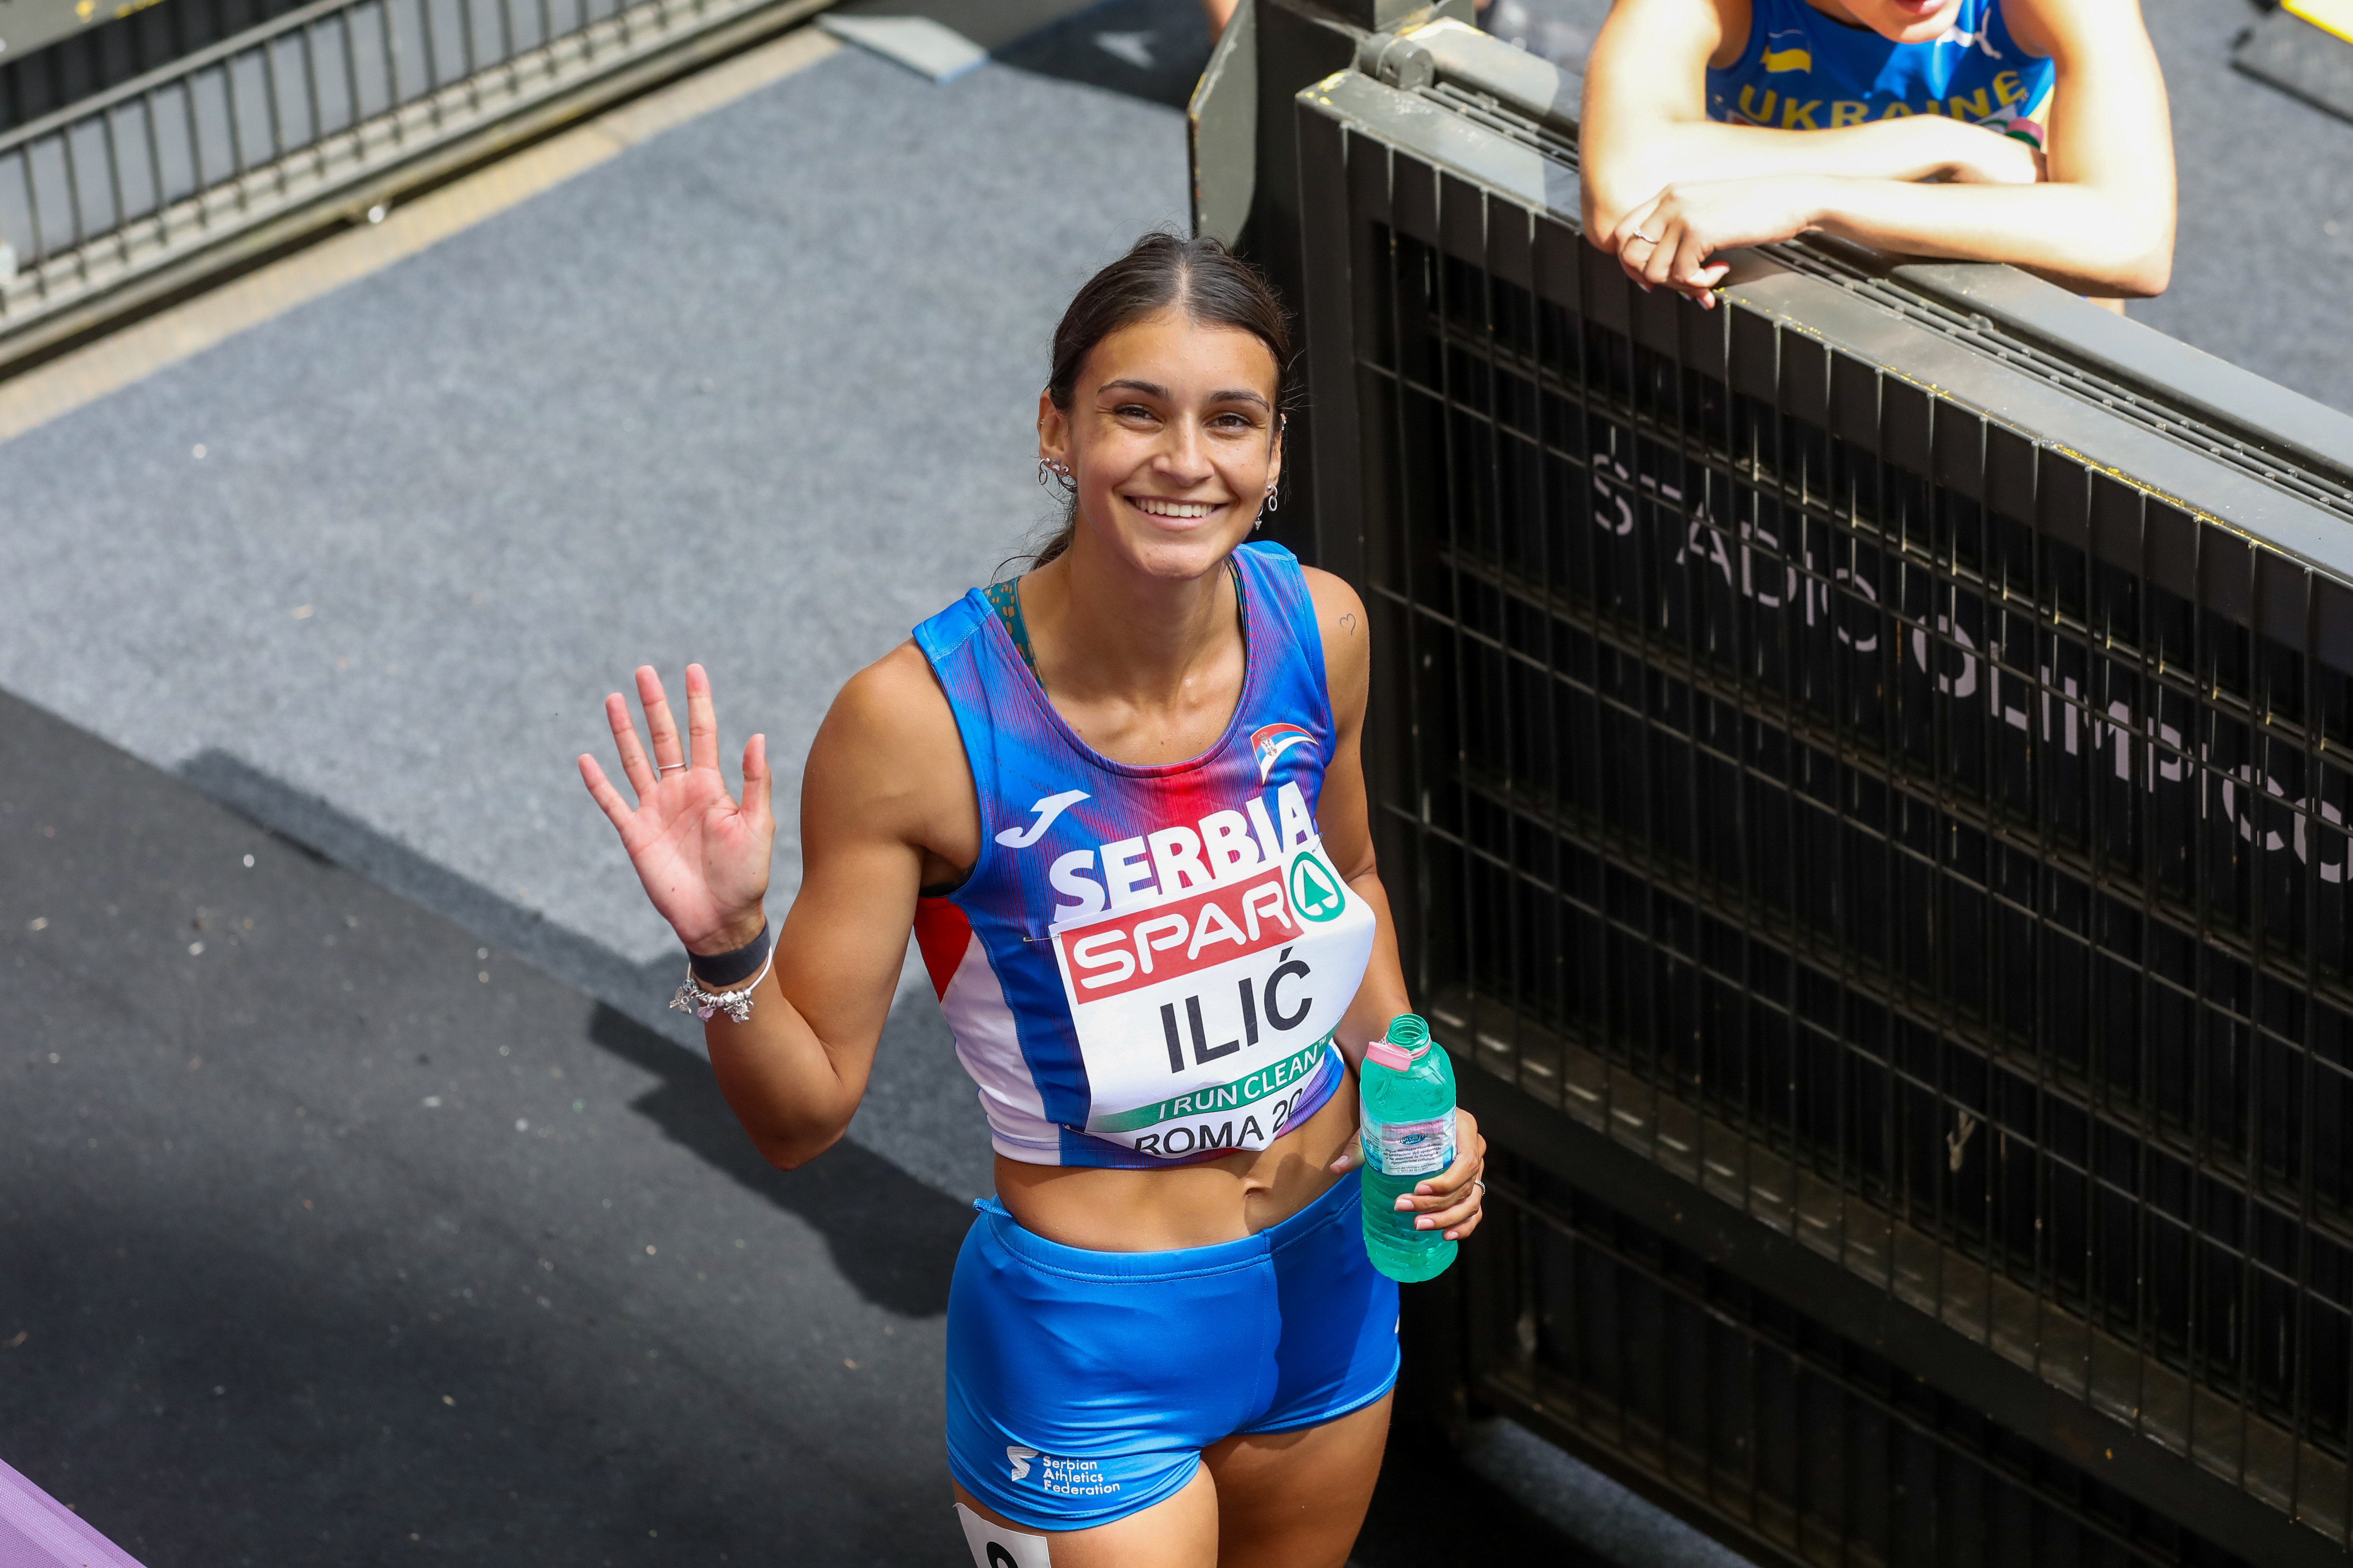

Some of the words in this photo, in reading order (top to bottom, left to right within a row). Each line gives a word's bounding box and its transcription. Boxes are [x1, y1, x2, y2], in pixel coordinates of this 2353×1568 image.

[1049, 780, 1315, 923] SERBIA
[1073, 881, 1291, 989] SPAR
[1160, 946, 1313, 1074] ILIĆ
[1159, 1104, 1165, 1119] I
[1174, 1084, 1238, 1115] RUN
[1134, 1116, 1265, 1155] ROMA
[1043, 1455, 1097, 1470] Serbian
[1043, 1468, 1104, 1483] Athletics
[1044, 1479, 1120, 1495] Federation
